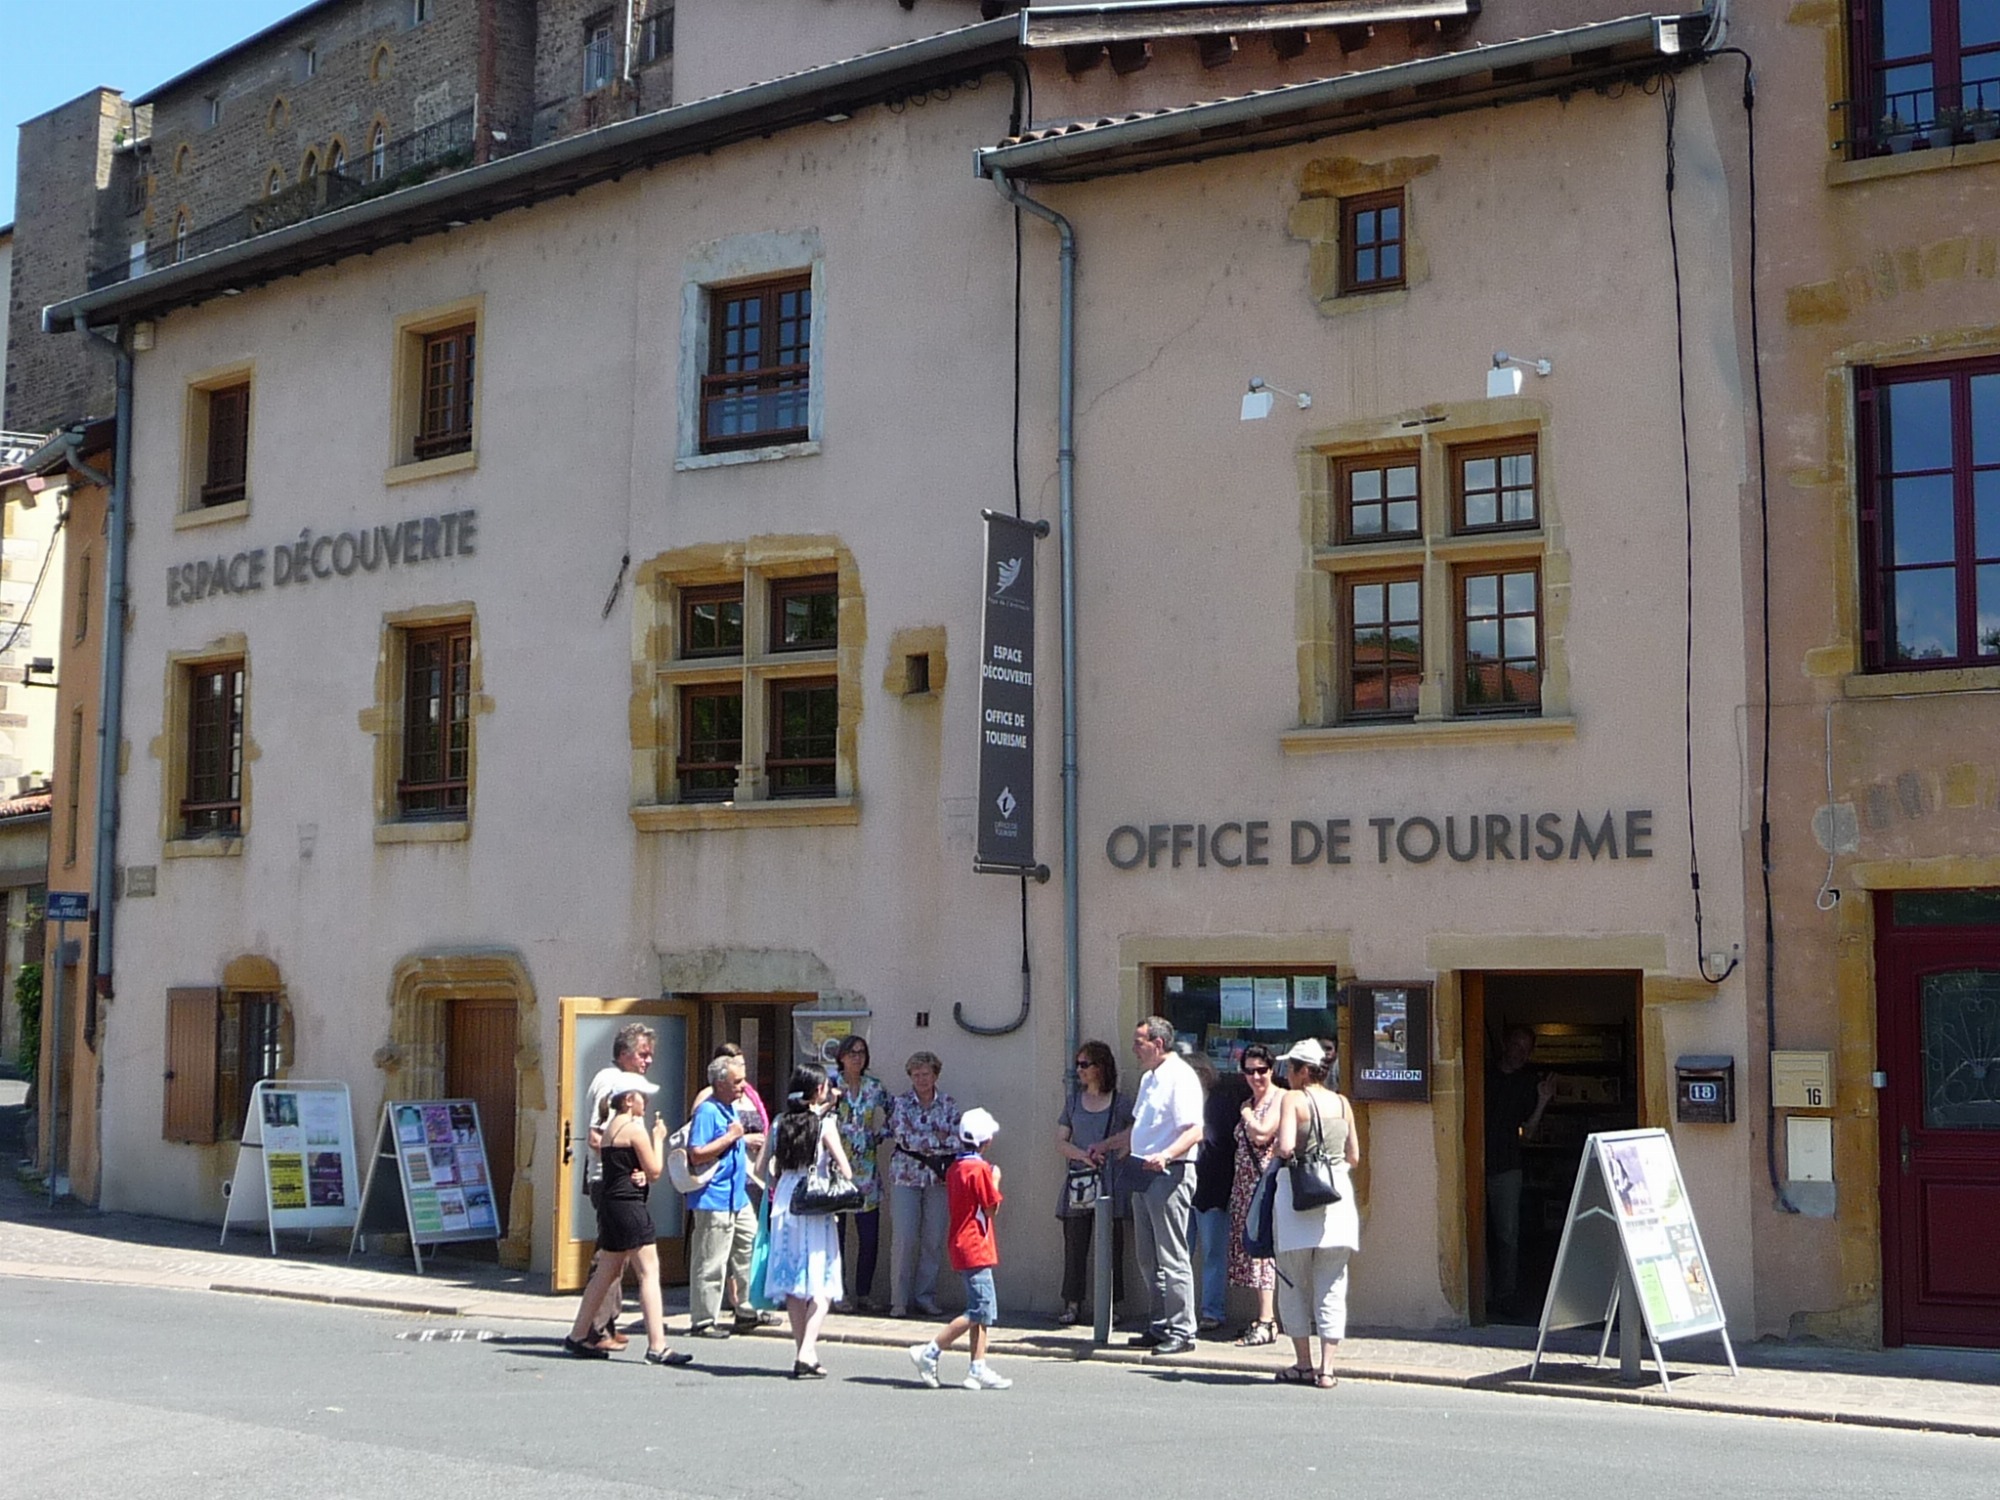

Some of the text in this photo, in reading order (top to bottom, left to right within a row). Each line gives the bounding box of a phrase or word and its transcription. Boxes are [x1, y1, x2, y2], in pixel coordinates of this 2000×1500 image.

[166, 509, 477, 606] ESPACE DÉCOUVERTE
[993, 645, 1022, 663] ESPACE
[982, 661, 1032, 685] DÉCOUVERTE
[985, 708, 1025, 727] OFFICE DE
[985, 730, 1027, 748] TOURISME
[1106, 809, 1653, 869] OFFICE DE TOURISME
[1363, 1070, 1421, 1079] EXPOSITION
[1693, 1086, 1712, 1099] 18
[1805, 1087, 1822, 1105] 16
